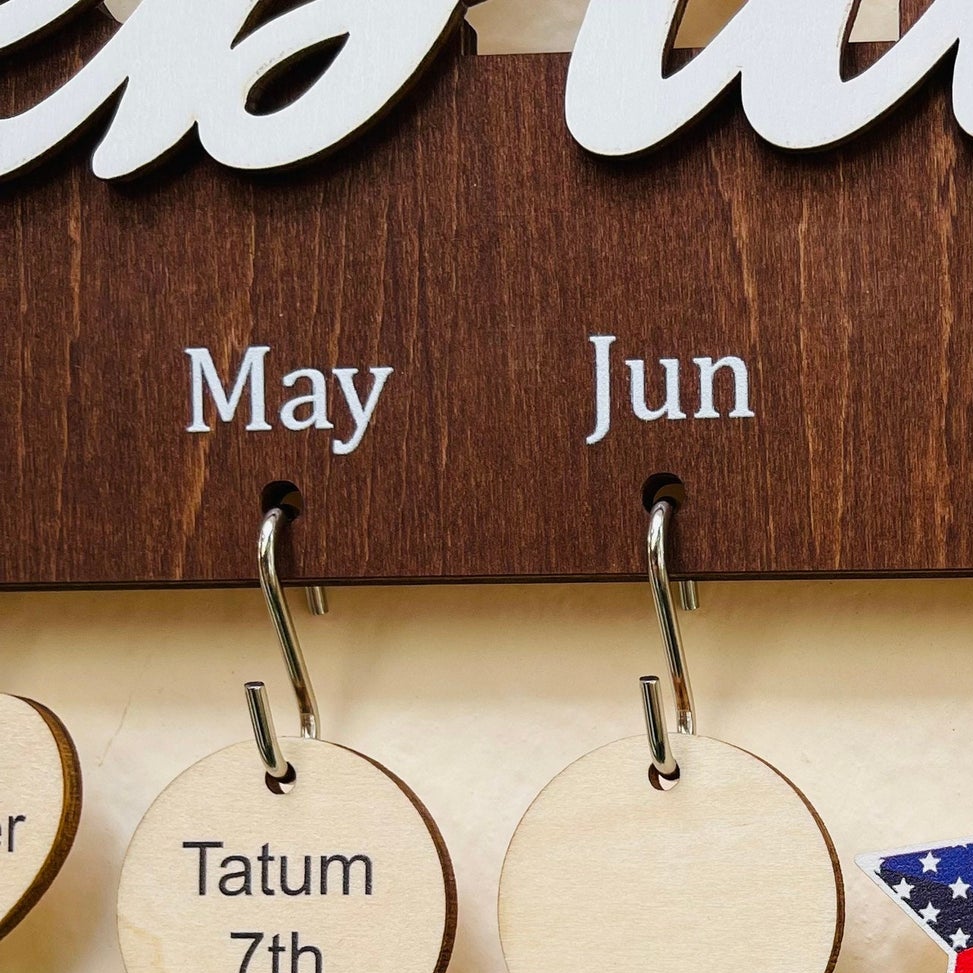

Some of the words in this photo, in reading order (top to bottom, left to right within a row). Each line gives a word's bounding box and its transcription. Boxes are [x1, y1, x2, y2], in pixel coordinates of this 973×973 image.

[185, 346, 393, 455] May
[586, 335, 755, 445] Jun
[182, 841, 373, 896] Tatum
